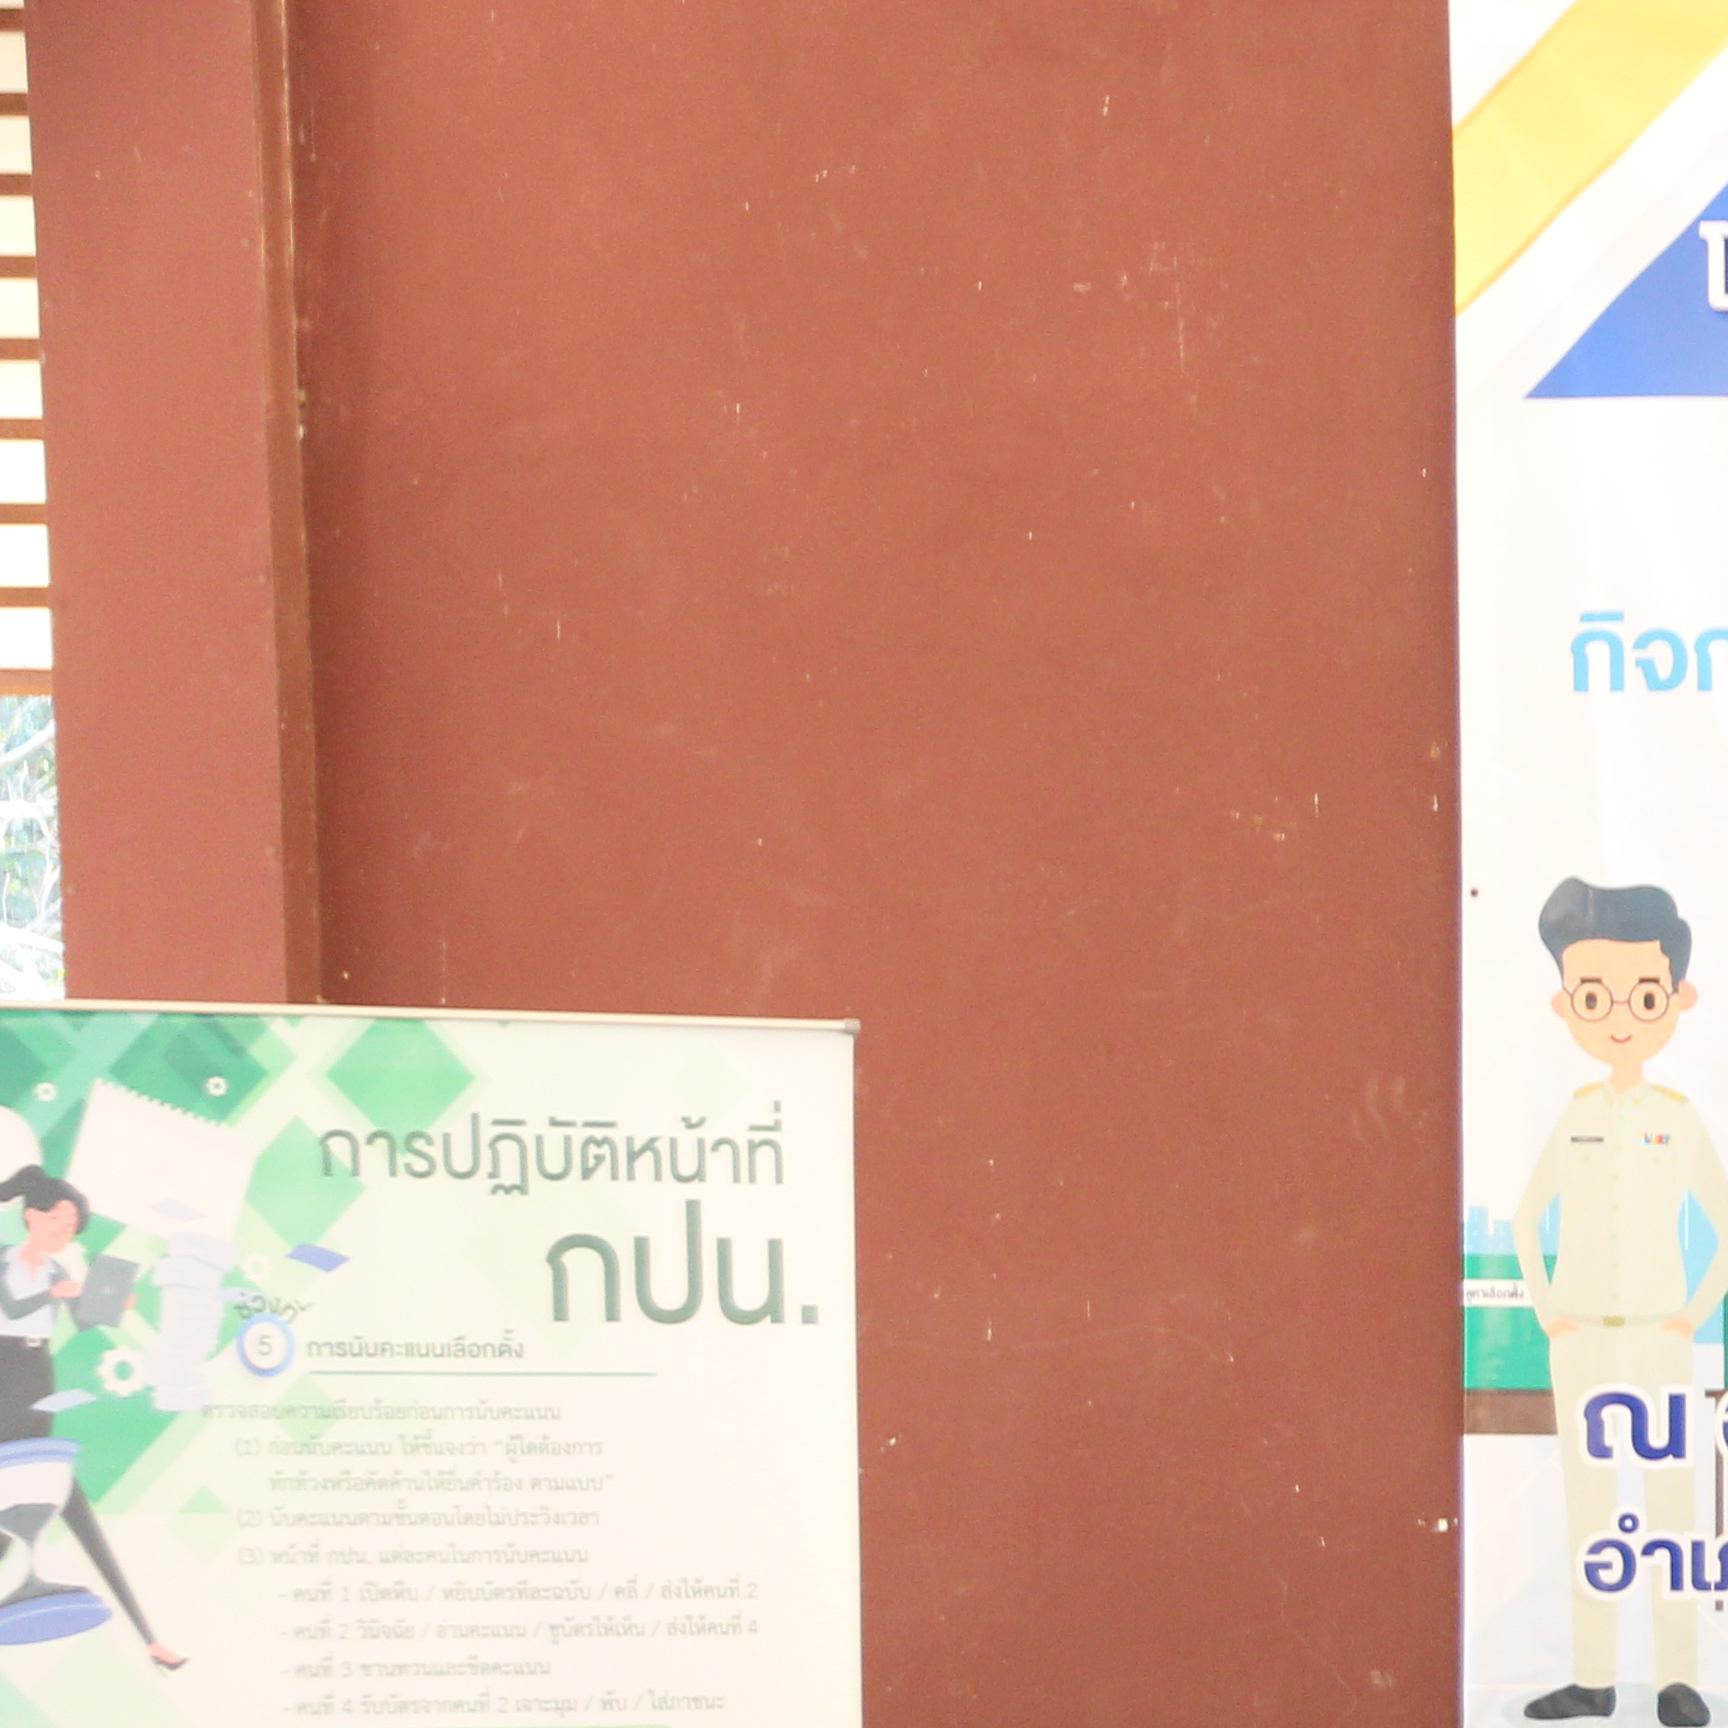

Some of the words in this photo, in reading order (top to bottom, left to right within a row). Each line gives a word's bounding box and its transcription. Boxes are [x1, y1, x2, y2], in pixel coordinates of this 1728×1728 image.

[319, 1101, 784, 1196] การปฏิบัติหน้าที่
[546, 1199, 820, 1326] กปน.
[257, 1334, 273, 1356] 5
[307, 1328, 525, 1359] การนับคะแนนเลือกตั้ง
[1584, 1390, 1684, 1461] ณ
